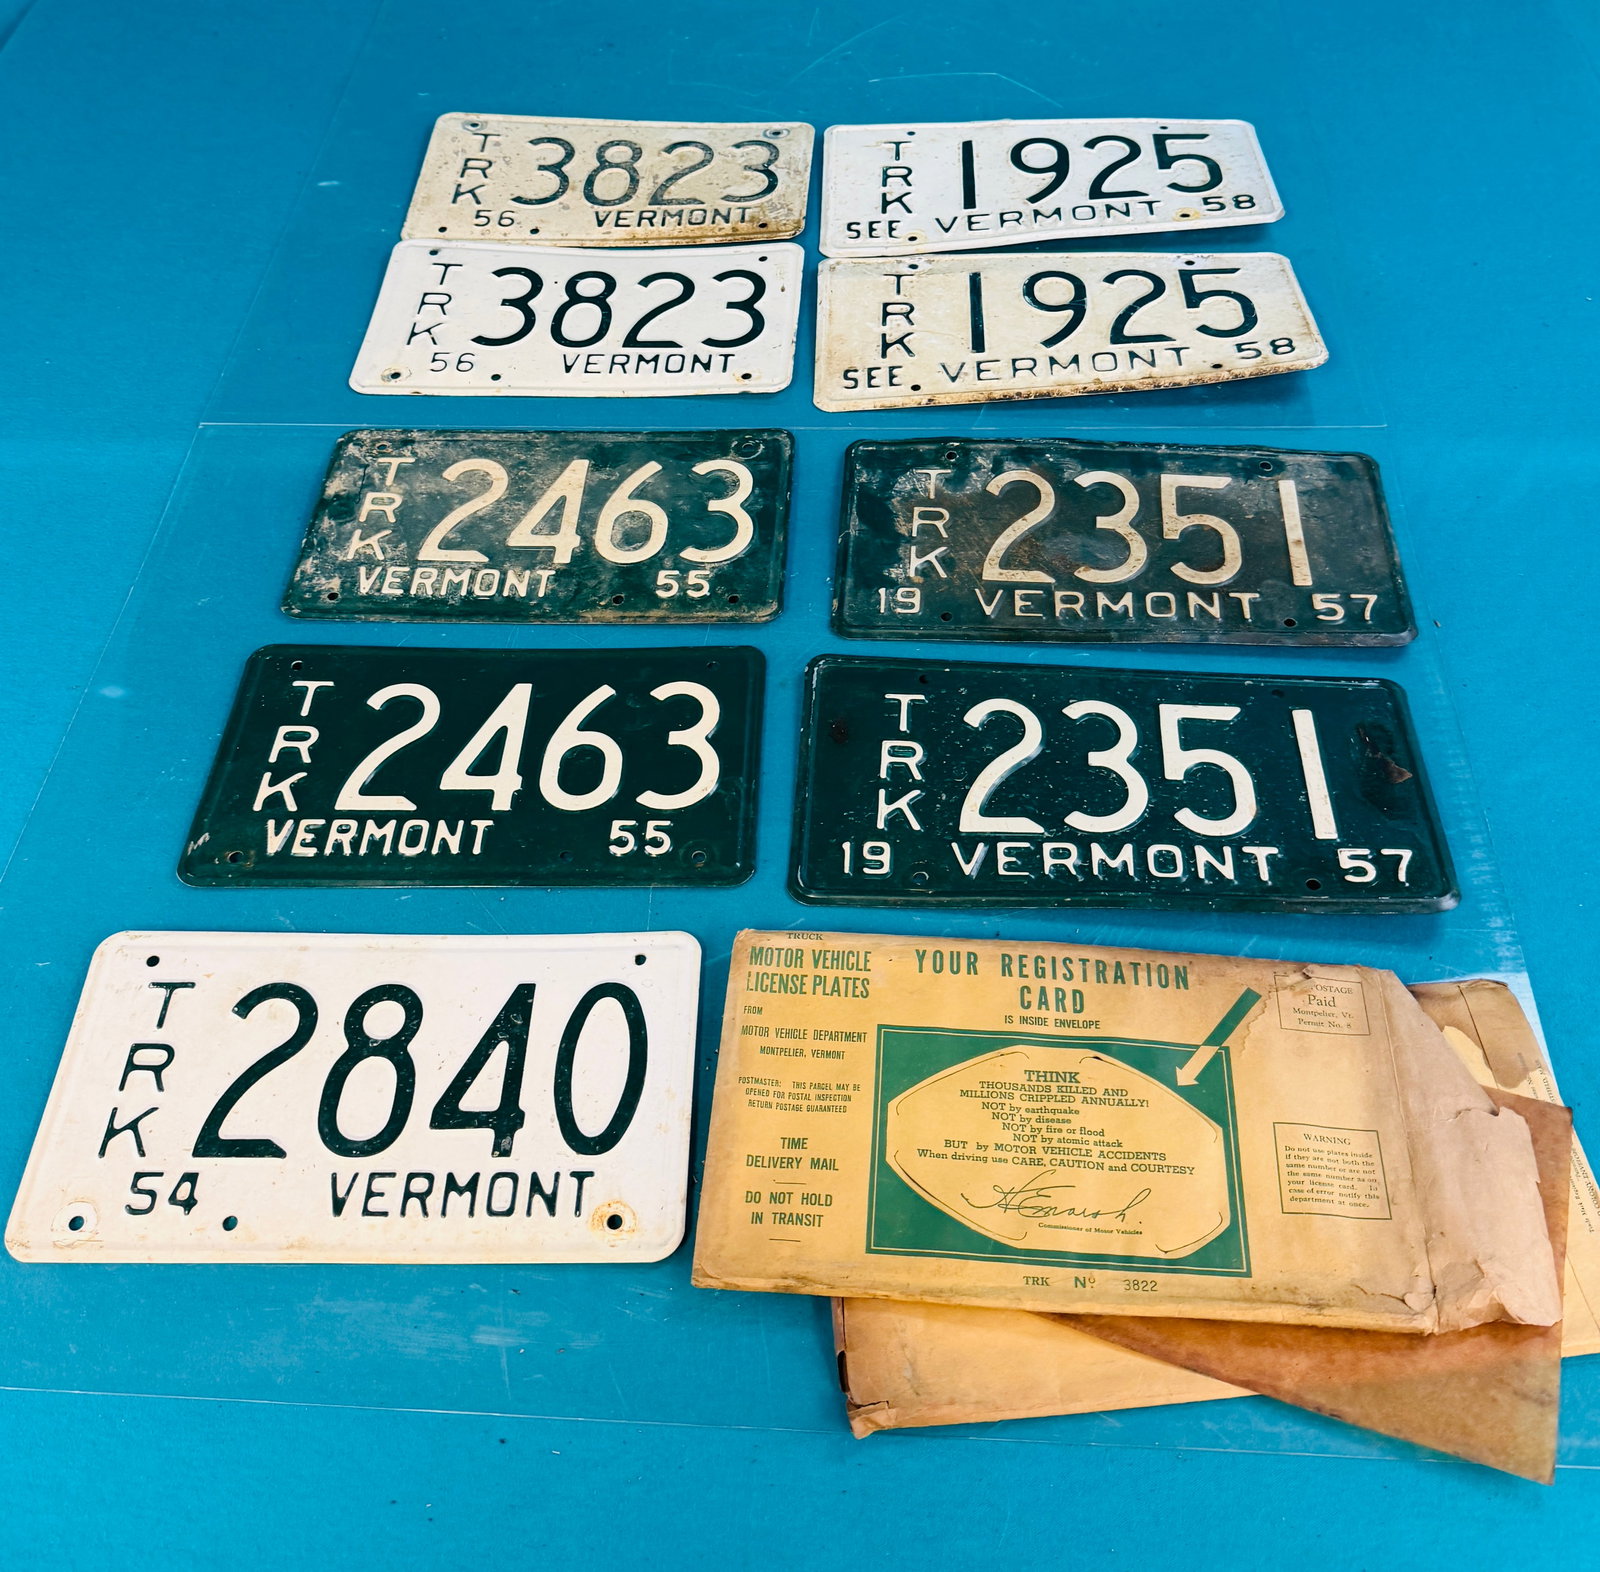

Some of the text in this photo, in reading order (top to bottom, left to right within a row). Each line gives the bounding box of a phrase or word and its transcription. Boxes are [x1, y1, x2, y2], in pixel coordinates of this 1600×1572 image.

[452, 133, 500, 204] TRK
[511, 136, 781, 206] 3823
[881, 141, 913, 214] TRK
[961, 133, 1224, 209] 1925
[474, 207, 752, 227] 56 VERMONT
[846, 194, 1257, 239] SEE VERMONT 58
[406, 263, 463, 346] TRK
[470, 267, 766, 348] 3823
[881, 273, 916, 359] TRK
[968, 267, 1259, 353] 1925
[430, 352, 735, 374] 56 VERMONT
[843, 338, 1296, 390] SEE VERMONT 58
[346, 457, 415, 561] TRK
[417, 459, 755, 564] 2463
[909, 469, 952, 578] TRK
[982, 469, 1313, 586] 2351
[358, 567, 711, 598] VERMONT 55
[878, 587, 1378, 621] 19 VERMONT 57
[252, 680, 335, 812] TRK
[334, 681, 721, 812] 2463
[876, 693, 929, 831] TRK
[959, 698, 1338, 840] 2351
[266, 819, 673, 857] VERMONT 55
[841, 841, 1413, 883] 19 VERMONT 57
[749, 946, 871, 972] MOTOR VEHICLE
[915, 949, 1189, 990] YOUR REGISTRATION
[746, 971, 870, 998] LICENSE PLATES
[1311, 984, 1353, 994] OSTAGE
[744, 1006, 762, 1015] FROM
[1020, 985, 1085, 1014] CARD
[1308, 994, 1336, 1007] Paid
[1004, 1015, 1100, 1029] IS INSIDE ENVELOPE
[1292, 1008, 1338, 1018] Montpelier,
[1297, 1018, 1324, 1027] Permit
[741, 1025, 867, 1043] MOTOR VEHICLE DEPARTMENT
[760, 1046, 845, 1060] MONTPELIER, VERMONT
[98, 982, 196, 1158] TRK
[191, 982, 648, 1158] 2840
[1024, 1070, 1080, 1083] THINK
[738, 1077, 781, 1087] POSTMASTER:
[792, 1081, 806, 1089] THIS
[809, 1083, 832, 1091] PARCEL
[745, 1088, 851, 1102] OPENED FOR POSTAL INSPECTION
[979, 1081, 1051, 1093] THOUSANDS
[1057, 1086, 1097, 1095] KILLED
[748, 1099, 847, 1113] RETURN POSTAGE GUARANTEED
[960, 1090, 1149, 1107] MILLIONS CRIPPLED ANNUALLY!
[981, 1102, 1079, 1115] NOT by earthquake
[992, 1112, 1071, 1124] NOT by disease
[1002, 1122, 1026, 1132] NOT
[1030, 1125, 1042, 1134] by
[1080, 1127, 1105, 1136] flood
[781, 1137, 808, 1149] TIME
[944, 1140, 1166, 1161] BUT by MOTOR VEHICLE ACCIDENTS
[1013, 1133, 1037, 1142] NOT
[1041, 1135, 1053, 1144] by
[1093, 1139, 1123, 1147] attack
[1304, 1133, 1351, 1145] WARNING
[746, 1155, 839, 1171] DELIVERY MAIL
[917, 1149, 948, 1159] When
[951, 1152, 988, 1163] driving
[1012, 1157, 1046, 1167] CARE,
[1050, 1158, 1104, 1170] CAUTION
[1131, 1164, 1195, 1174] COURTESY
[1308, 1164, 1336, 1172] number
[125, 1171, 595, 1218] 54 VERMONT
[745, 1191, 832, 1207] DO NOT HOLD
[1290, 1196, 1335, 1204] department
[751, 1212, 824, 1227] IN TRANSIT
[1038, 1223, 1082, 1231] Commissioner
[1023, 1276, 1050, 1286] TRK
[1124, 1280, 1158, 1292] 3822
